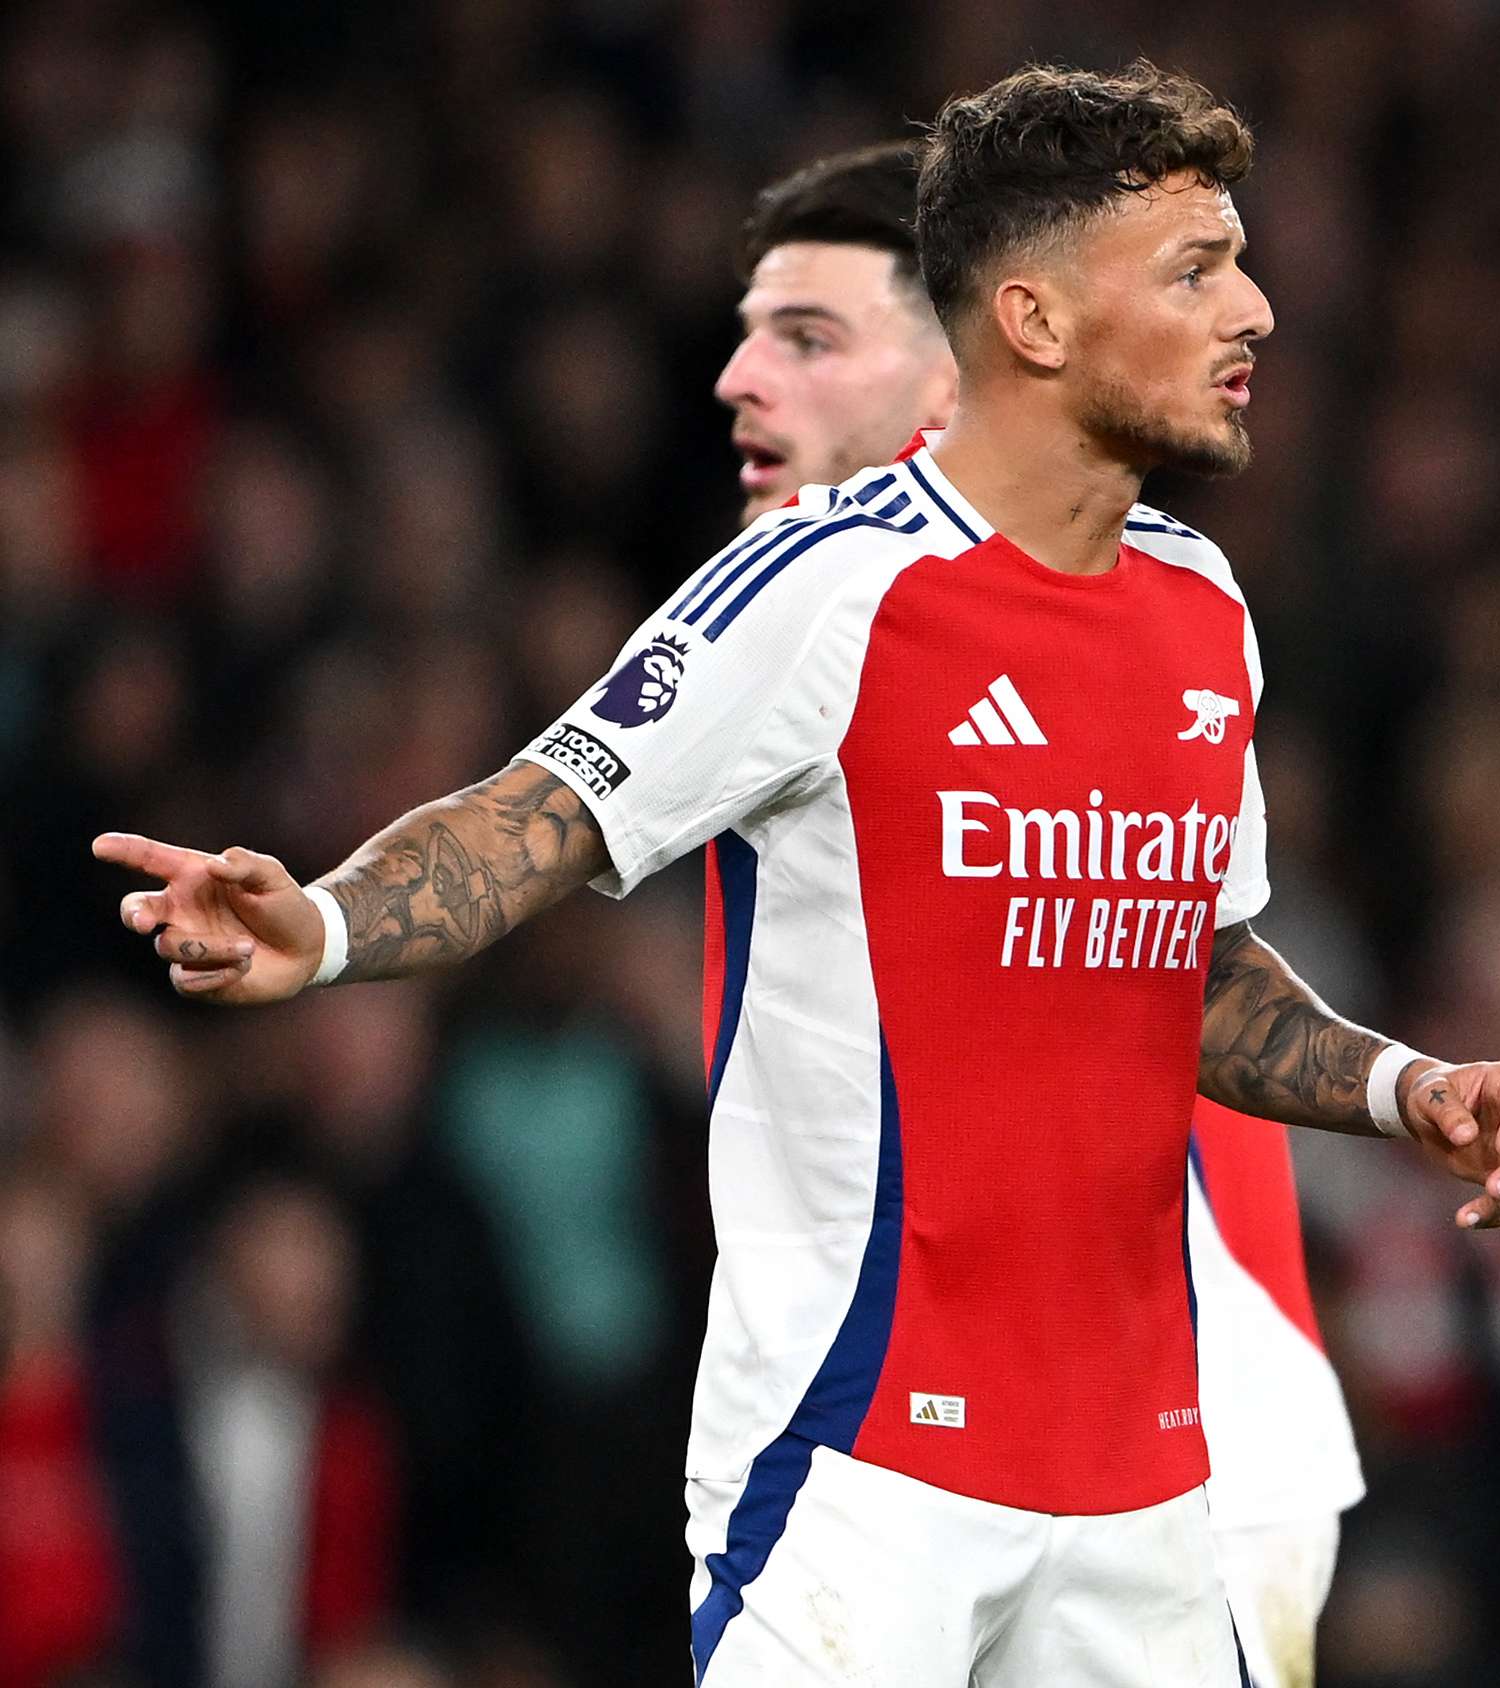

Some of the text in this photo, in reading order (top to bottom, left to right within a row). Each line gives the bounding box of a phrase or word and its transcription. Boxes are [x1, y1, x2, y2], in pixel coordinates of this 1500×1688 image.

[545, 743, 612, 800] racism
[561, 730, 619, 778] room
[1001, 897, 1207, 970] FLY BETTER
